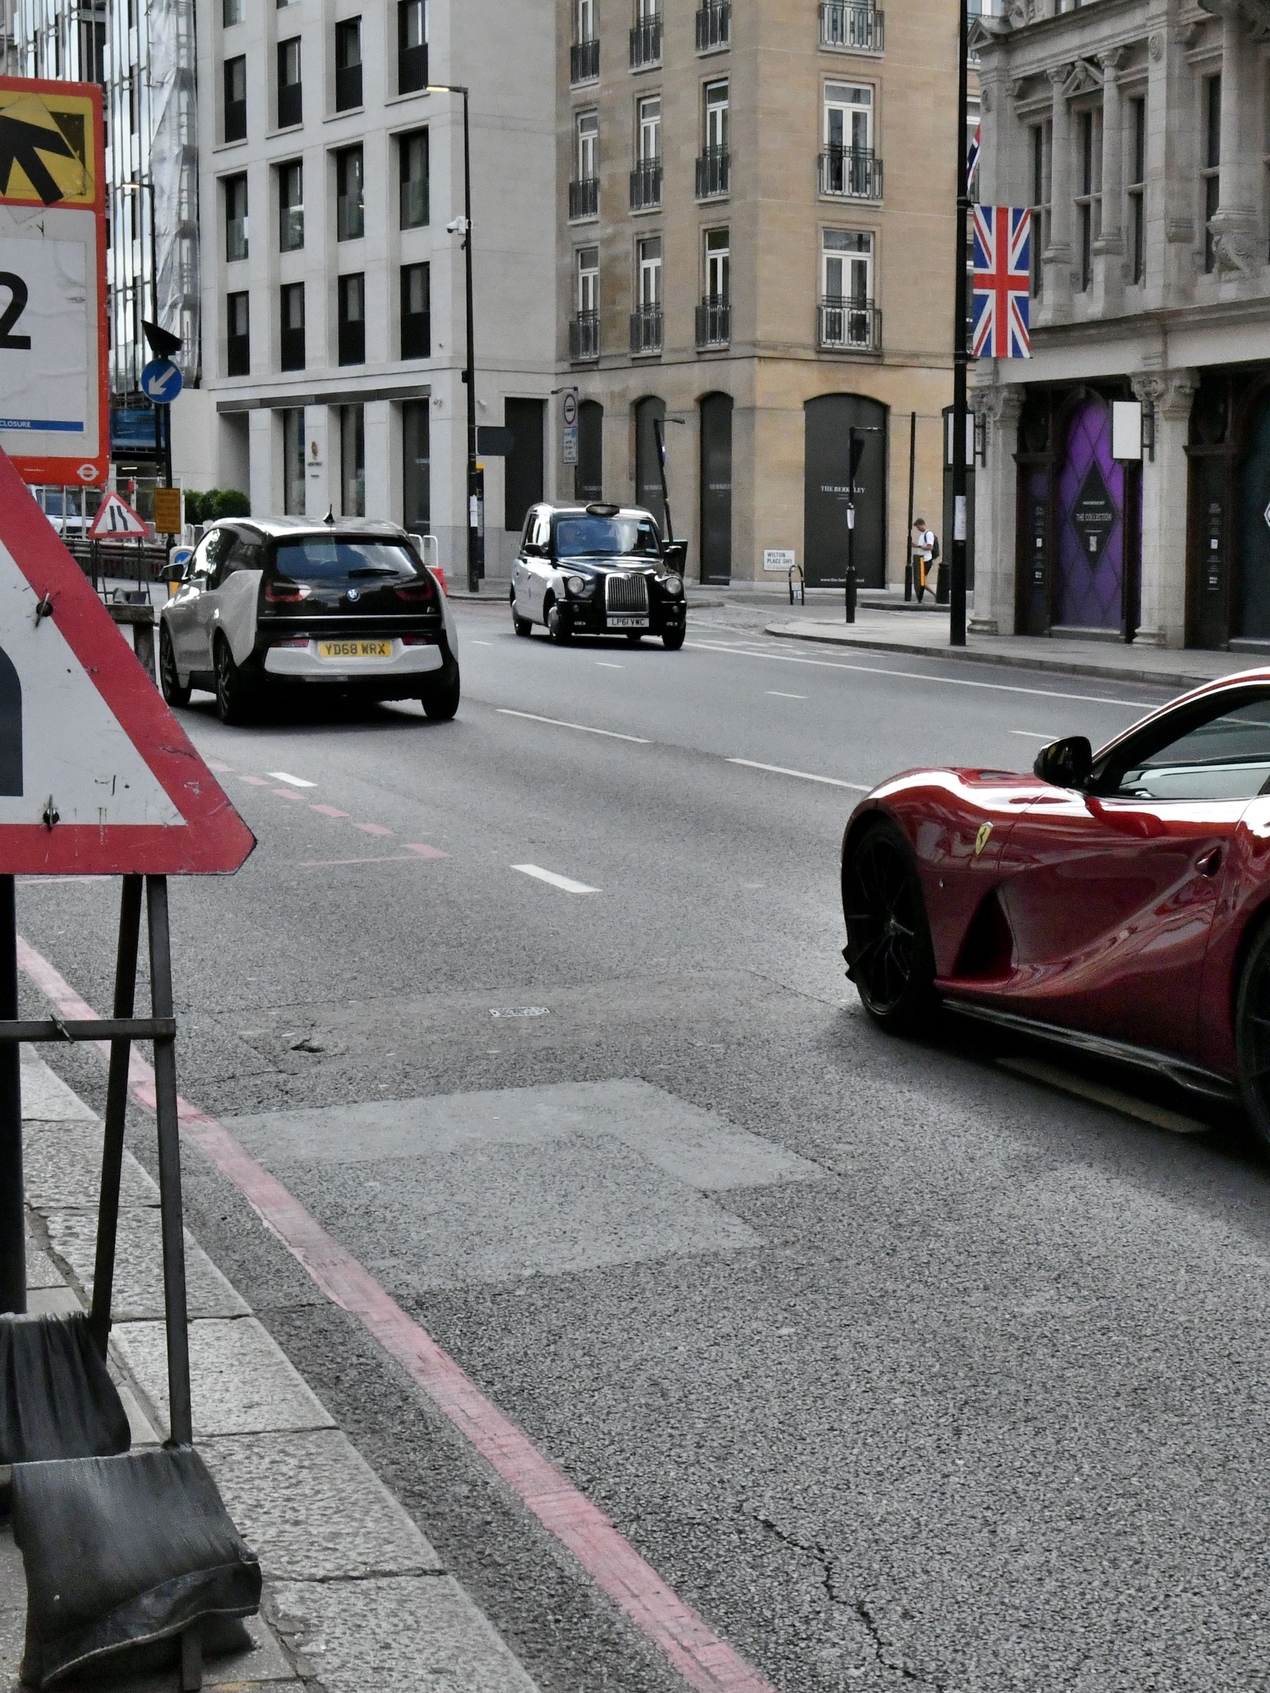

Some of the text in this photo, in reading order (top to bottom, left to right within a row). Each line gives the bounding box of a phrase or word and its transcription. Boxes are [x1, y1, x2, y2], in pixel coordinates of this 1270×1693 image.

[612, 618, 629, 626] LP61
[325, 643, 386, 655] YD68 WRX
